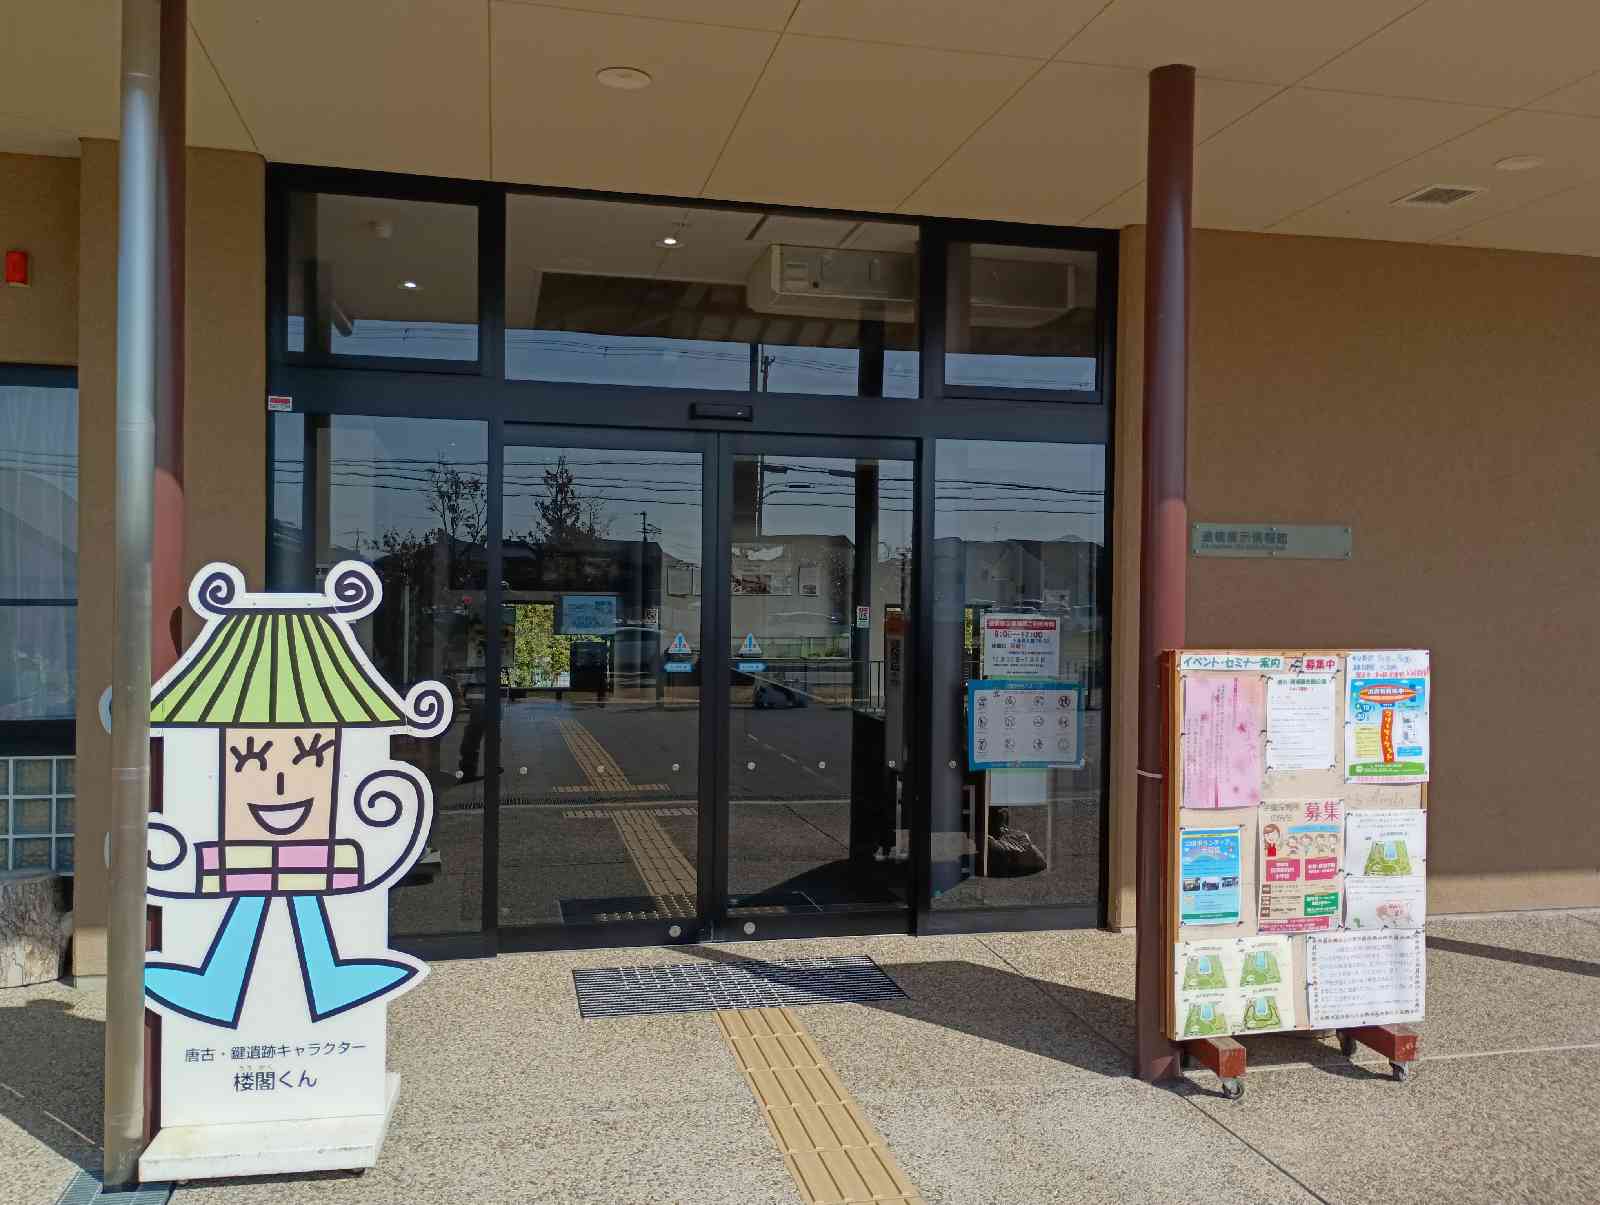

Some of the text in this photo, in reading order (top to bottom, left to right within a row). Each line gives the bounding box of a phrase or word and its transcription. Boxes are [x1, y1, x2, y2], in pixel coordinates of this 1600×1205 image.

[1183, 656, 1281, 669] イベント・セミナー案内
[1304, 658, 1336, 670] 募集中
[1303, 800, 1341, 822] 募集
[184, 1041, 367, 1063] 唐古・鍵遺跡キャラクター
[233, 1069, 319, 1092] 楼閣くん
